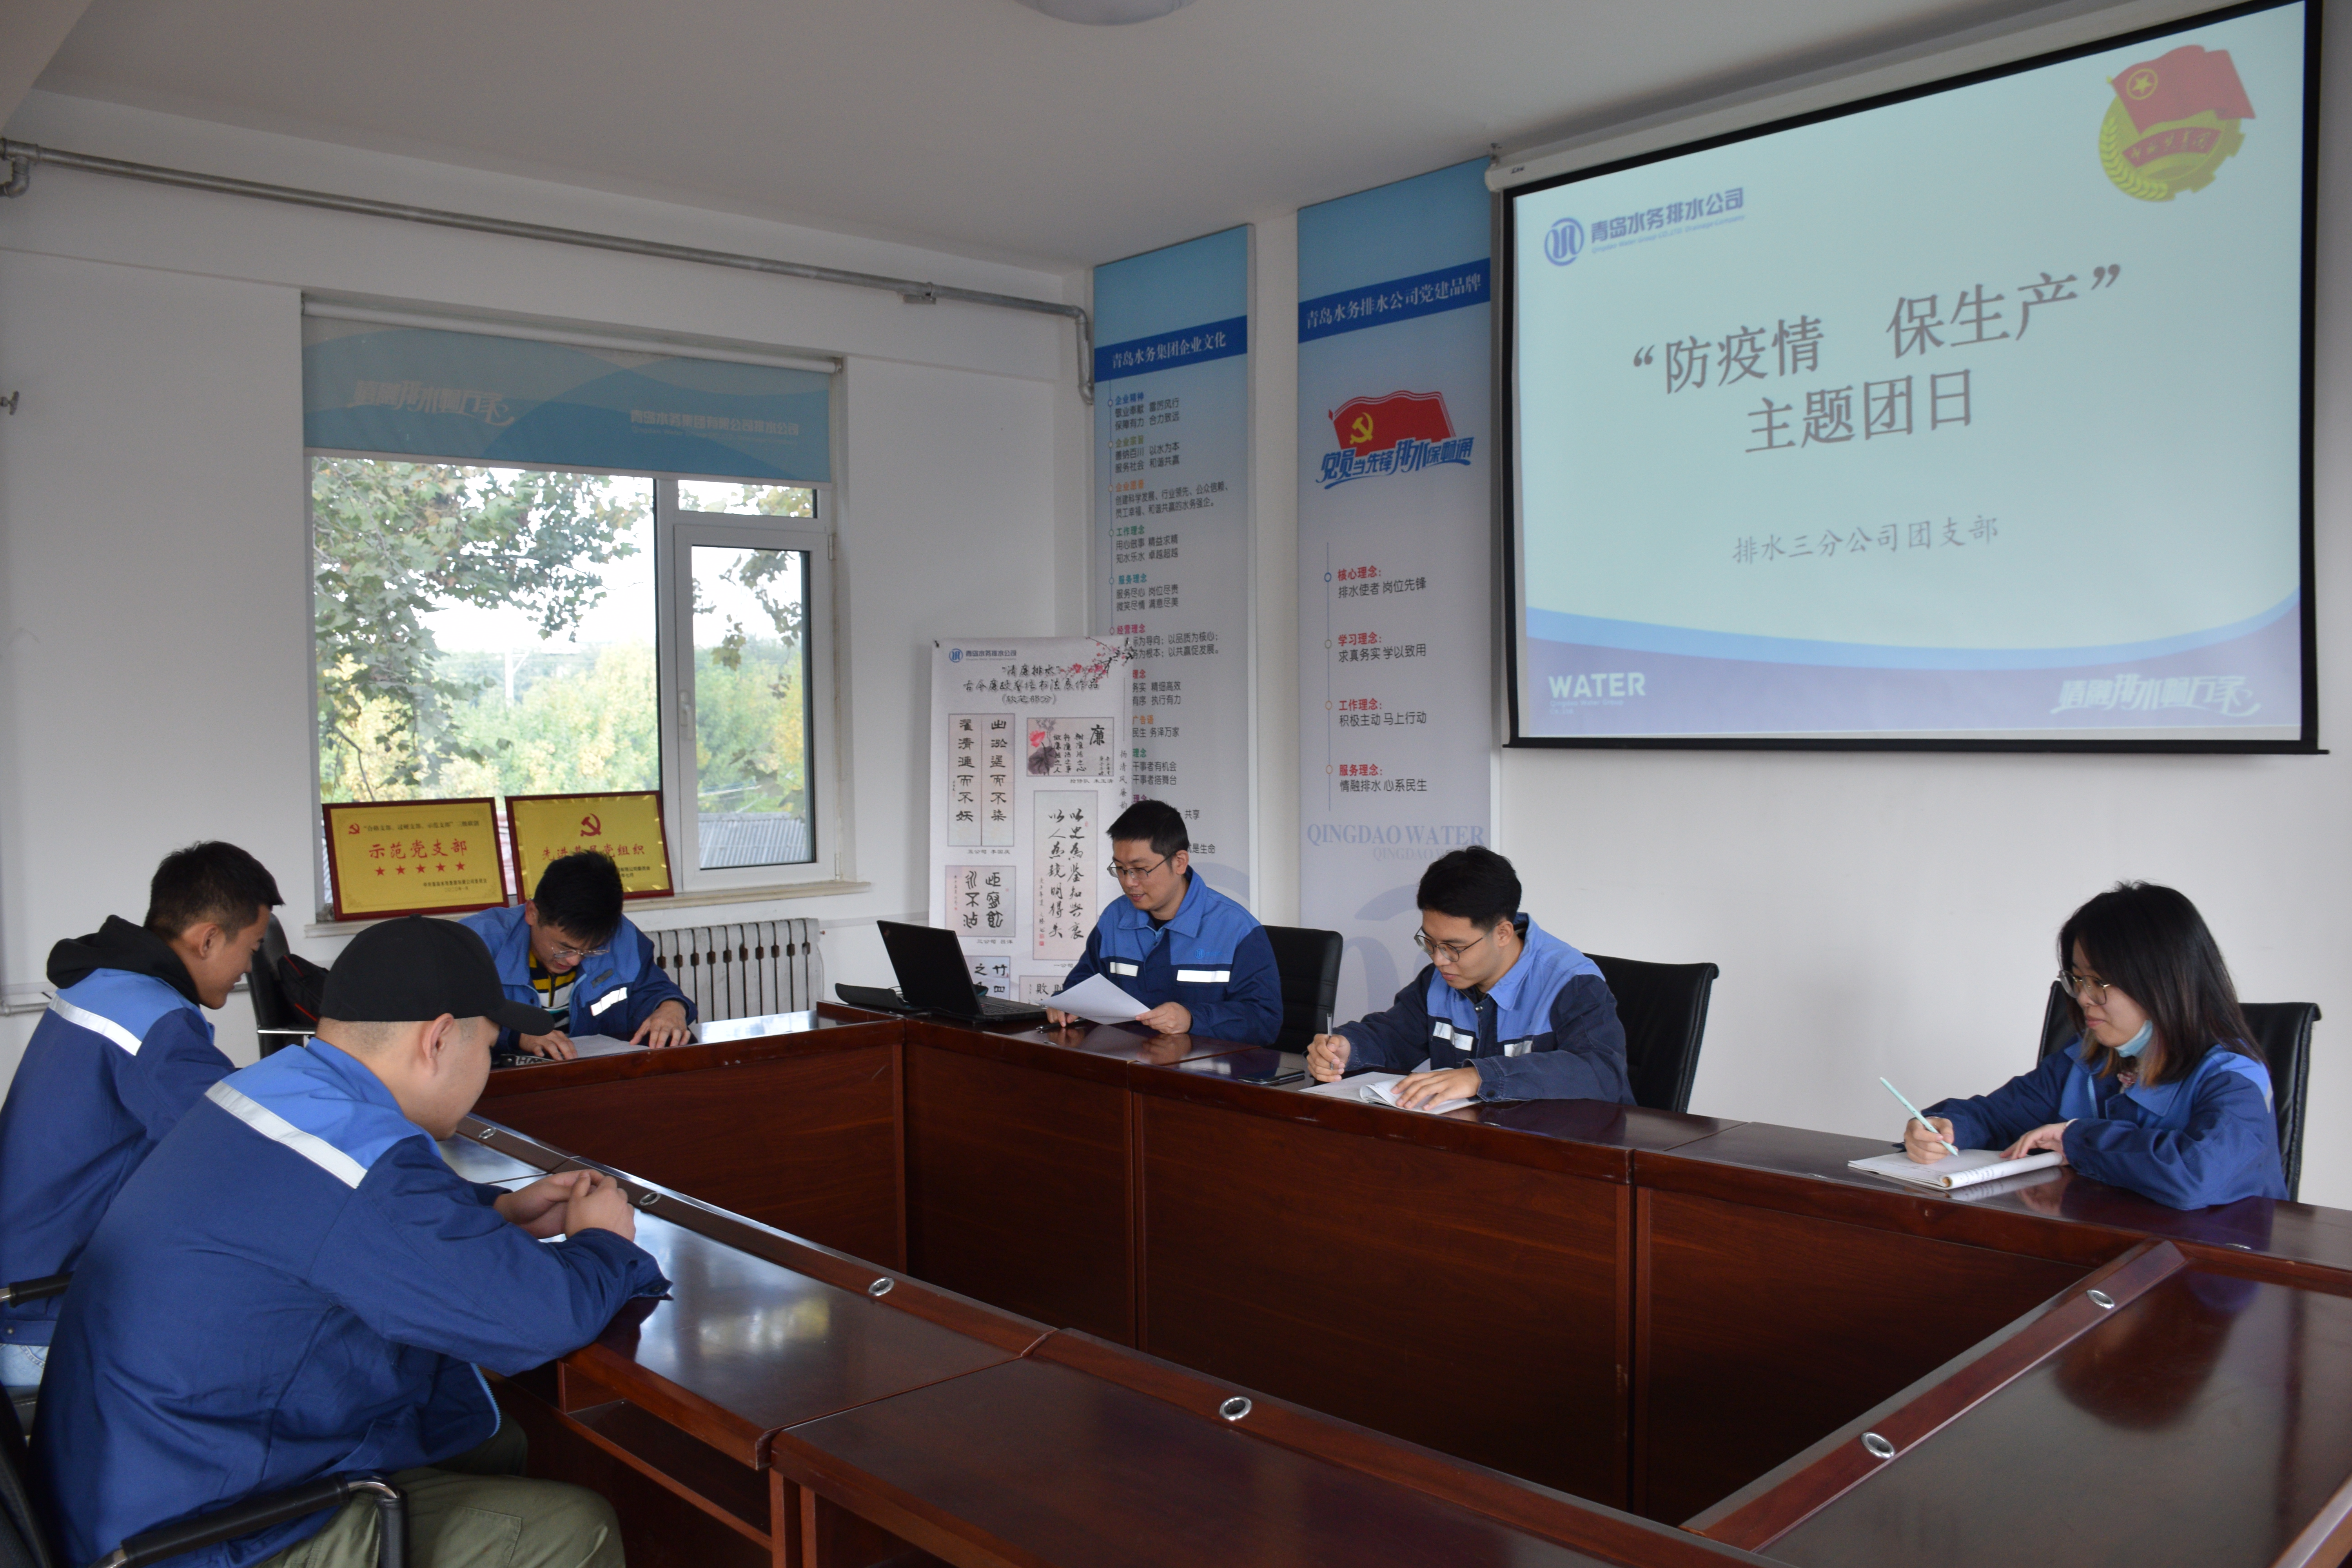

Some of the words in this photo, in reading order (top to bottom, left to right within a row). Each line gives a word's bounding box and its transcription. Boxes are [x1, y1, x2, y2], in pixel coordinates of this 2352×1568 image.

[1591, 187, 1743, 244] 青岛水务排水公司
[1307, 273, 1481, 329] 青岛水务排水公司党建品牌
[1633, 315, 1825, 394] “防疫情
[1886, 264, 2120, 360] 保生产”
[1113, 331, 1226, 369] 青岛水务集团企业文化
[1116, 404, 1144, 417] 敬业奉献
[1149, 397, 1179, 412] 雷厉风行
[1745, 369, 1972, 453] 主题团日
[1115, 418, 1144, 430] 保障有力
[1149, 411, 1179, 425] 合力致远
[1150, 442, 1180, 455] 以水为本
[1116, 460, 1144, 473] 服务社会
[1150, 455, 1179, 468] 和谐共赢
[1116, 525, 1144, 536] 工作理念
[1116, 538, 1145, 550] 用心做事
[1149, 534, 1178, 546] 精益求精
[1733, 515, 1998, 564] 排水三分公司团支部
[1116, 552, 1145, 563] 知水乐水
[1149, 548, 1178, 559] 卓越超越
[1118, 573, 1147, 584] 服务理念
[1116, 587, 1145, 599] 服务尽心
[1149, 584, 1178, 597] 岗位尽责
[1338, 581, 1379, 598] 排水使者
[1383, 577, 1426, 594] 岗位先锋
[1117, 600, 1145, 612] 微笑尽情
[1149, 597, 1178, 609] 满意尽美
[1117, 624, 1145, 634] 经营理念
[1338, 648, 1380, 662] 求真务实
[1383, 643, 1426, 660] 学以致用
[1133, 669, 1146, 679] 理念
[1151, 681, 1181, 692] 精细高效
[1549, 672, 1646, 698] WATER
[1151, 695, 1181, 705] 执行有力
[1132, 715, 1154, 724] 广告语
[1339, 713, 1381, 727] 积极主动
[1383, 711, 1426, 725] 马上行动
[1090, 724, 1105, 746] 廉
[1132, 728, 1146, 737] 民生
[1150, 727, 1179, 737] 务泽万家
[1133, 748, 1147, 758] 理念
[1133, 761, 1176, 771] 干事者有机会
[1133, 775, 1176, 785] 干事者搭舞台
[1340, 779, 1381, 792] 情融排水
[1384, 779, 1427, 792] 心系民生
[1185, 809, 1200, 820] 共享
[1307, 824, 1401, 846] QINGDAO
[1405, 825, 1485, 846] WATER
[369, 838, 467, 859] 示范党支部
